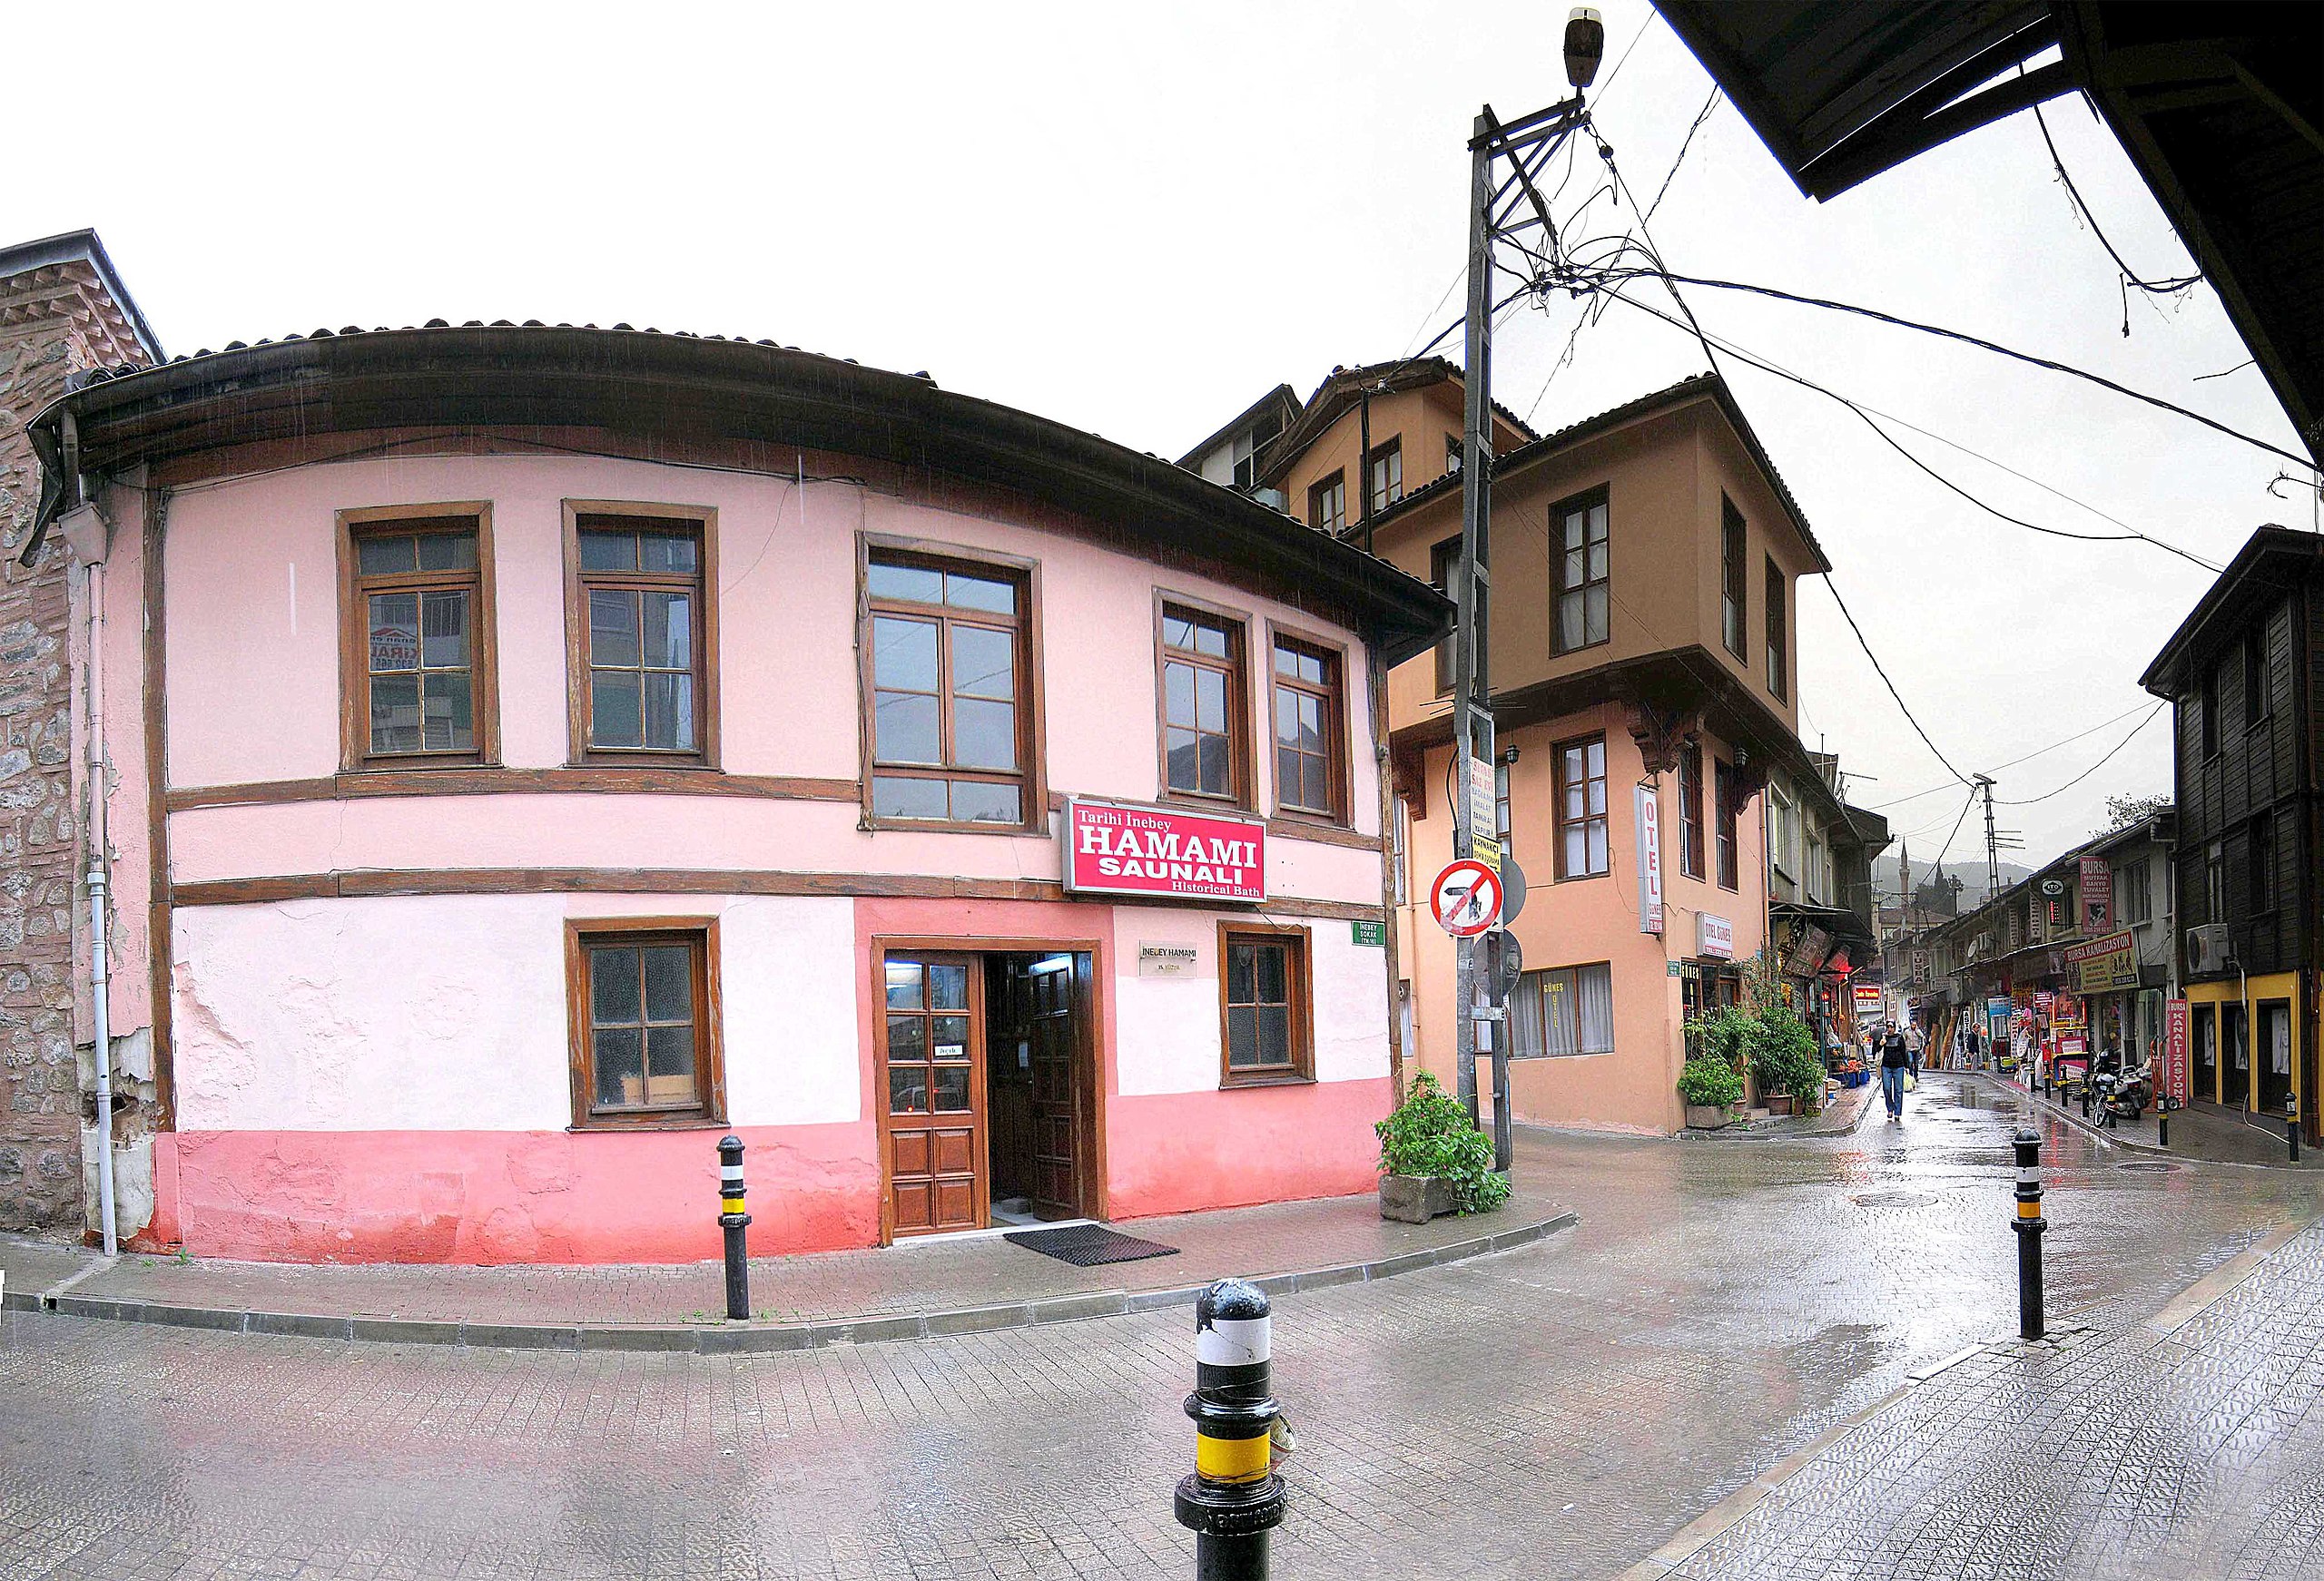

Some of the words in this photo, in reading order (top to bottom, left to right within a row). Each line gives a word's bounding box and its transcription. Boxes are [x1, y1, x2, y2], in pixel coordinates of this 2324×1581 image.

[1078, 809, 1122, 826] Tarihi
[1127, 811, 1172, 833] İnebey
[1078, 825, 1257, 869] HAMAMI
[1474, 836, 1499, 856] KAYNAKÇI
[1645, 801, 1658, 896] OTEL
[1098, 857, 1243, 885] SAUNALI
[2082, 860, 2110, 874] BURSA
[1172, 880, 1231, 895] Historical
[1234, 886, 1260, 898] Bath
[1705, 922, 1716, 939] OTEL
[1168, 948, 1196, 957] HAMAMI
[2067, 948, 2085, 961] BURSA
[2171, 1003, 2185, 1011] BURSA
